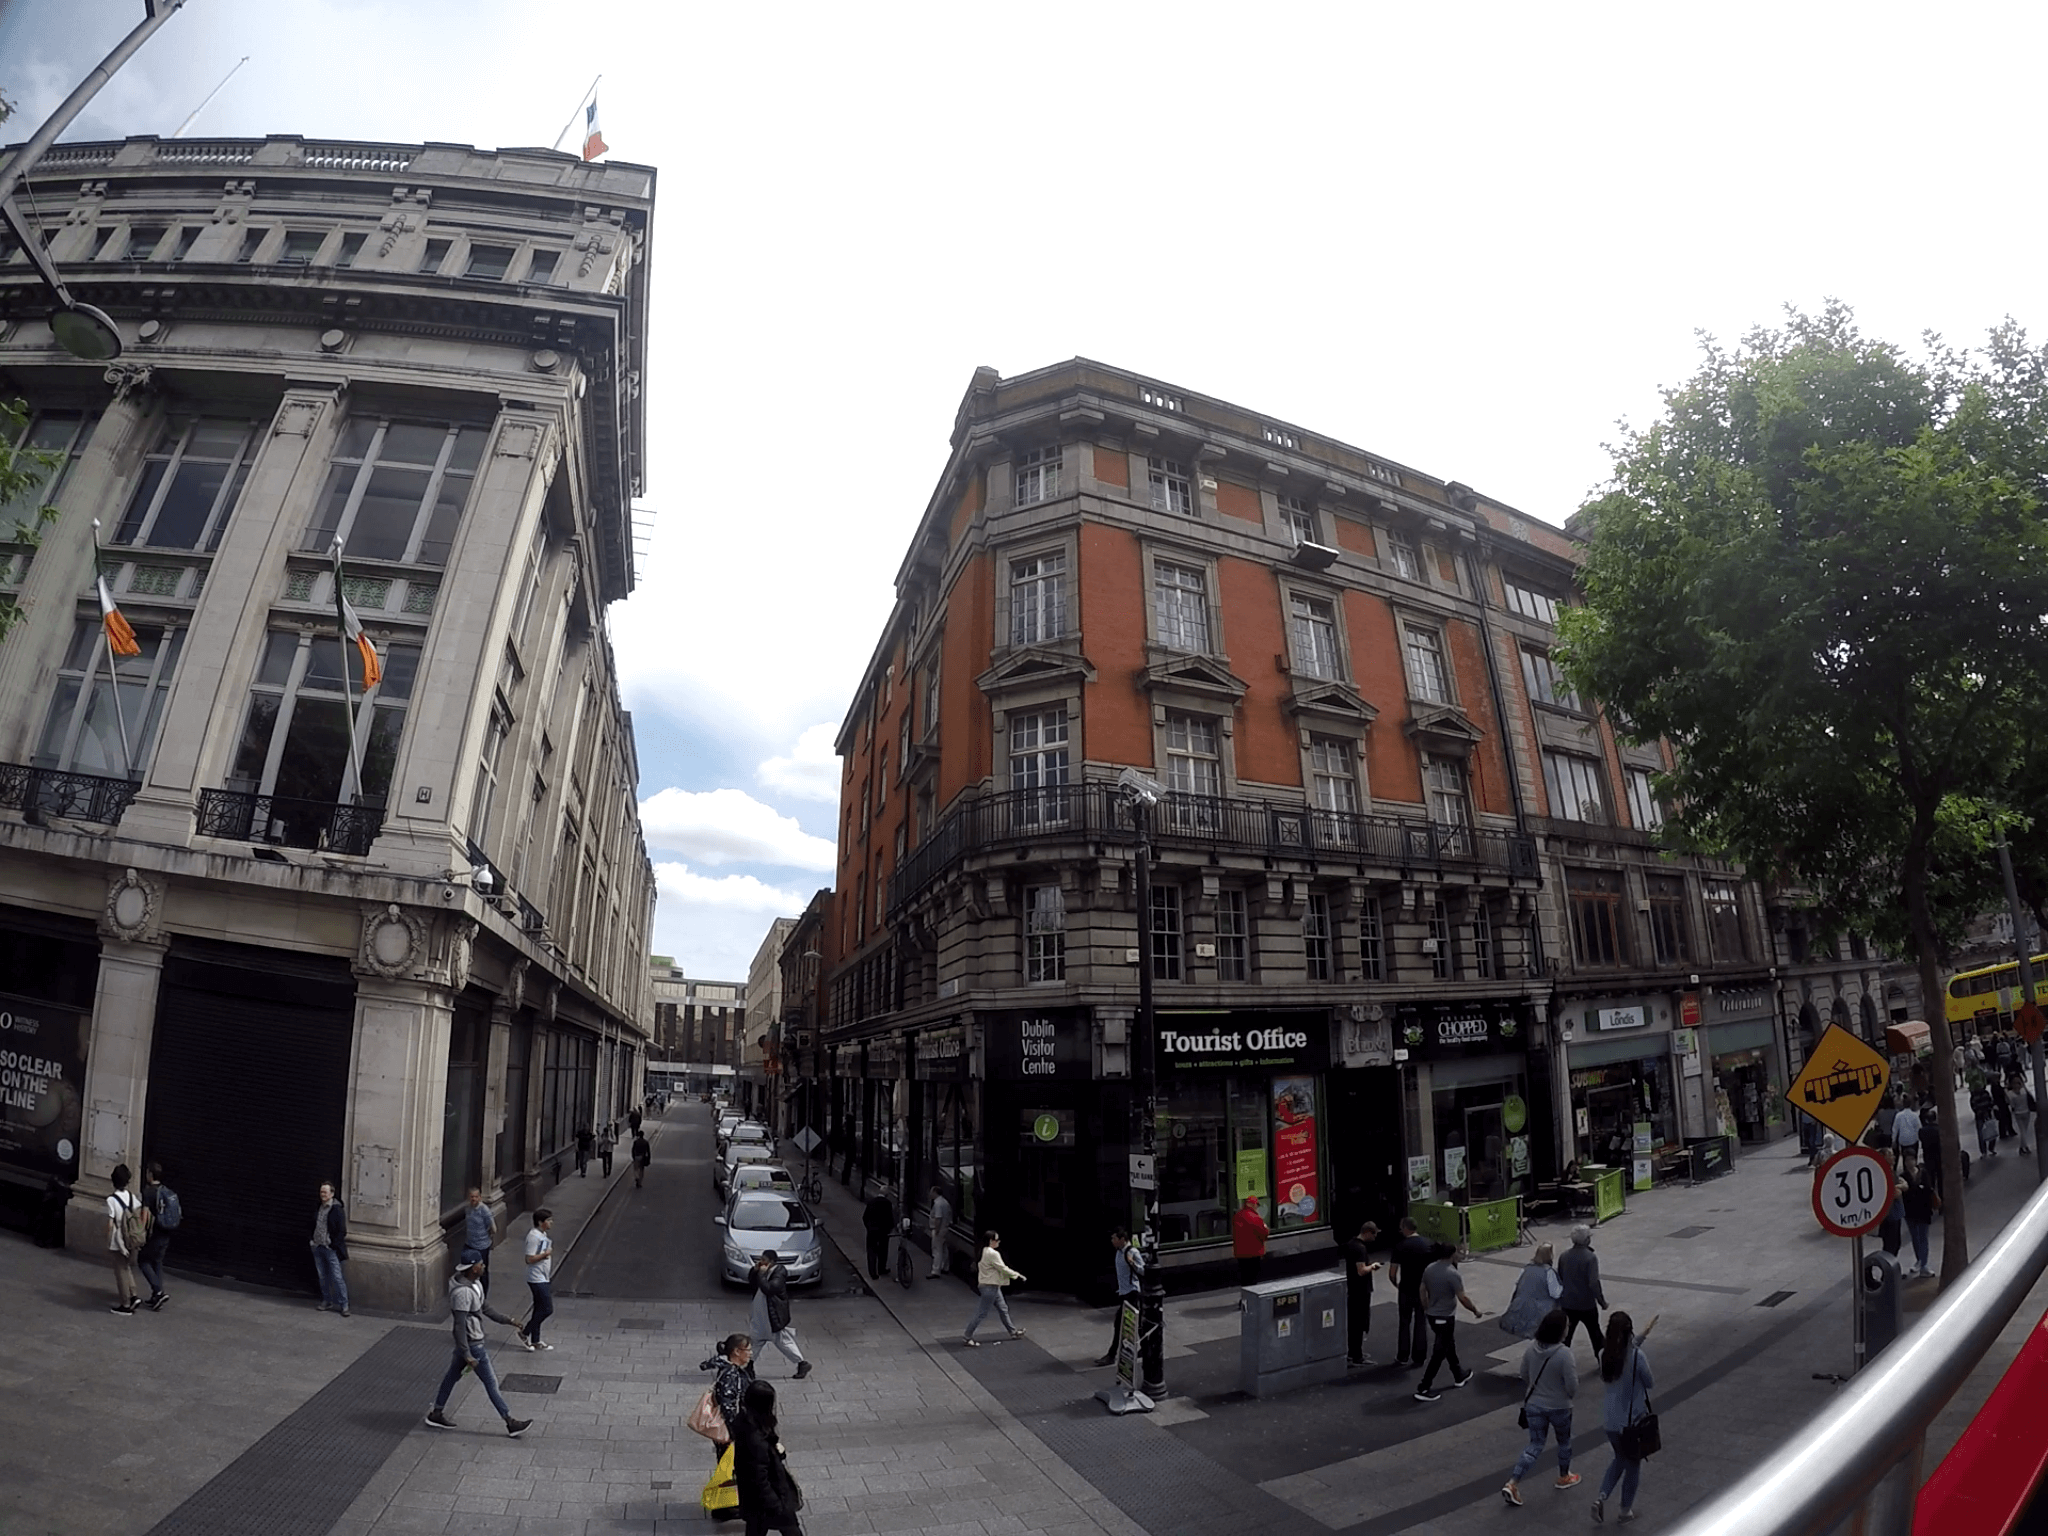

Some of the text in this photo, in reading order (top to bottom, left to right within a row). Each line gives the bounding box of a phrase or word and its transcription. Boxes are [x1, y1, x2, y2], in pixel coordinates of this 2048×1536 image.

[1021, 1018, 1055, 1038] Dublin
[1438, 1019, 1488, 1037] CHOPPED
[1609, 1013, 1635, 1026] Londis
[940, 1036, 960, 1059] Office
[1021, 1038, 1056, 1056] Visitor
[1160, 1025, 1308, 1052] Tourist Office
[0, 1049, 63, 1080] SO CLEAR
[1021, 1057, 1056, 1075] Centre
[2, 1069, 48, 1095] ON THE
[1835, 1166, 1873, 1208] 30
[1840, 1208, 1872, 1225] km/h
